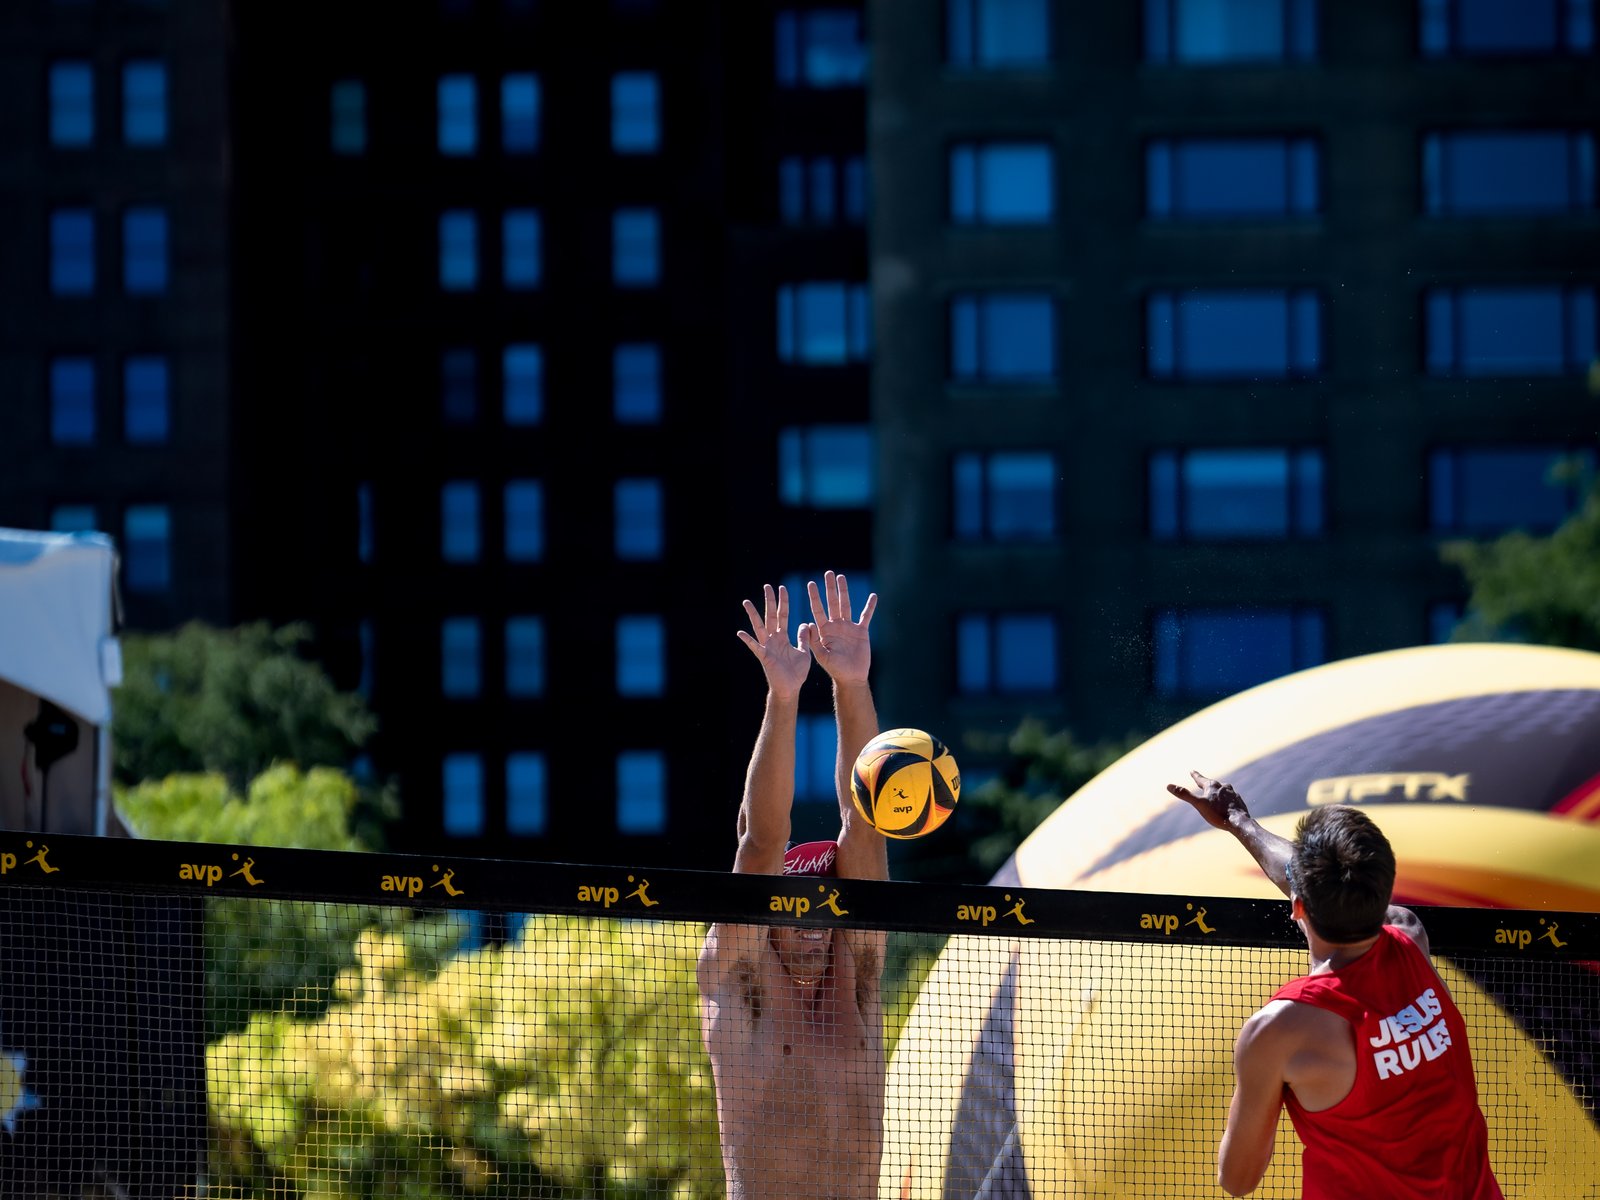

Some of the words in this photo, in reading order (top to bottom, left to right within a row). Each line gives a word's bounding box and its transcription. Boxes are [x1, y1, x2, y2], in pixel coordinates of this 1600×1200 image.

[893, 805, 913, 814] avp
[180, 864, 222, 887] avp
[381, 876, 423, 898] avp
[578, 886, 619, 908] avp
[770, 896, 811, 918] avp
[957, 905, 997, 927] avp
[1141, 914, 1179, 935] avp
[1496, 930, 1532, 950] avp
[1369, 988, 1442, 1048] JESUS
